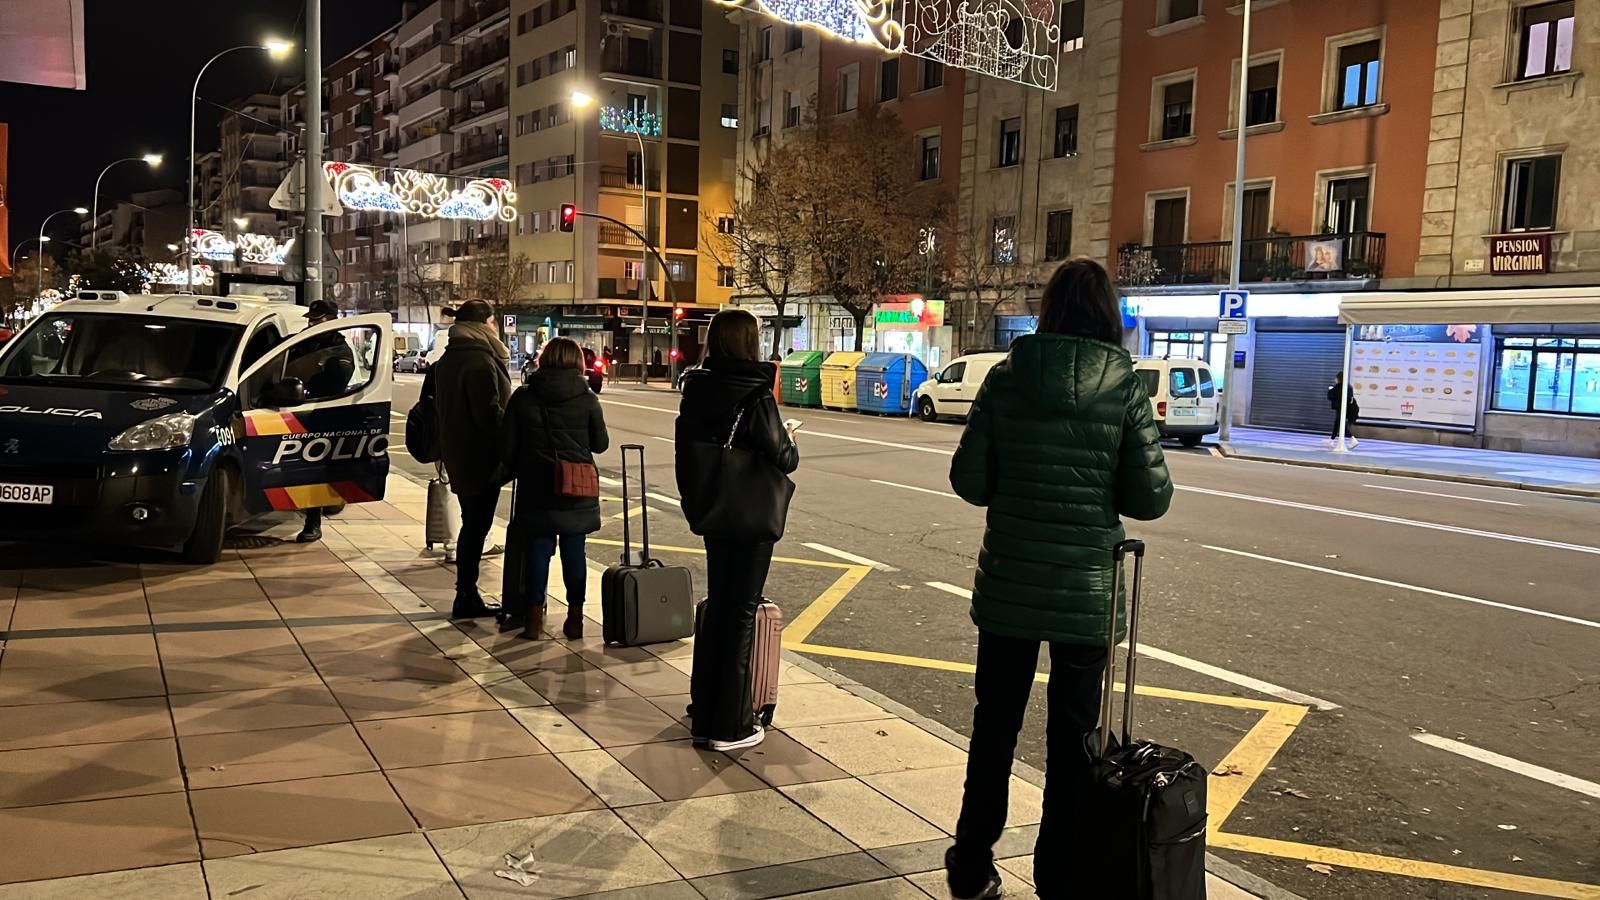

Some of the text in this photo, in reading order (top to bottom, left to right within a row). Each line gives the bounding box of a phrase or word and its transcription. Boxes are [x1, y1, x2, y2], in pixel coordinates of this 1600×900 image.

[1496, 239, 1540, 253] PENSION
[1493, 254, 1543, 271] VIRGINIA
[1221, 294, 1243, 318] P
[506, 317, 514, 327] P
[322, 429, 369, 438] NACIONAL
[0, 485, 50, 502] 608AP
